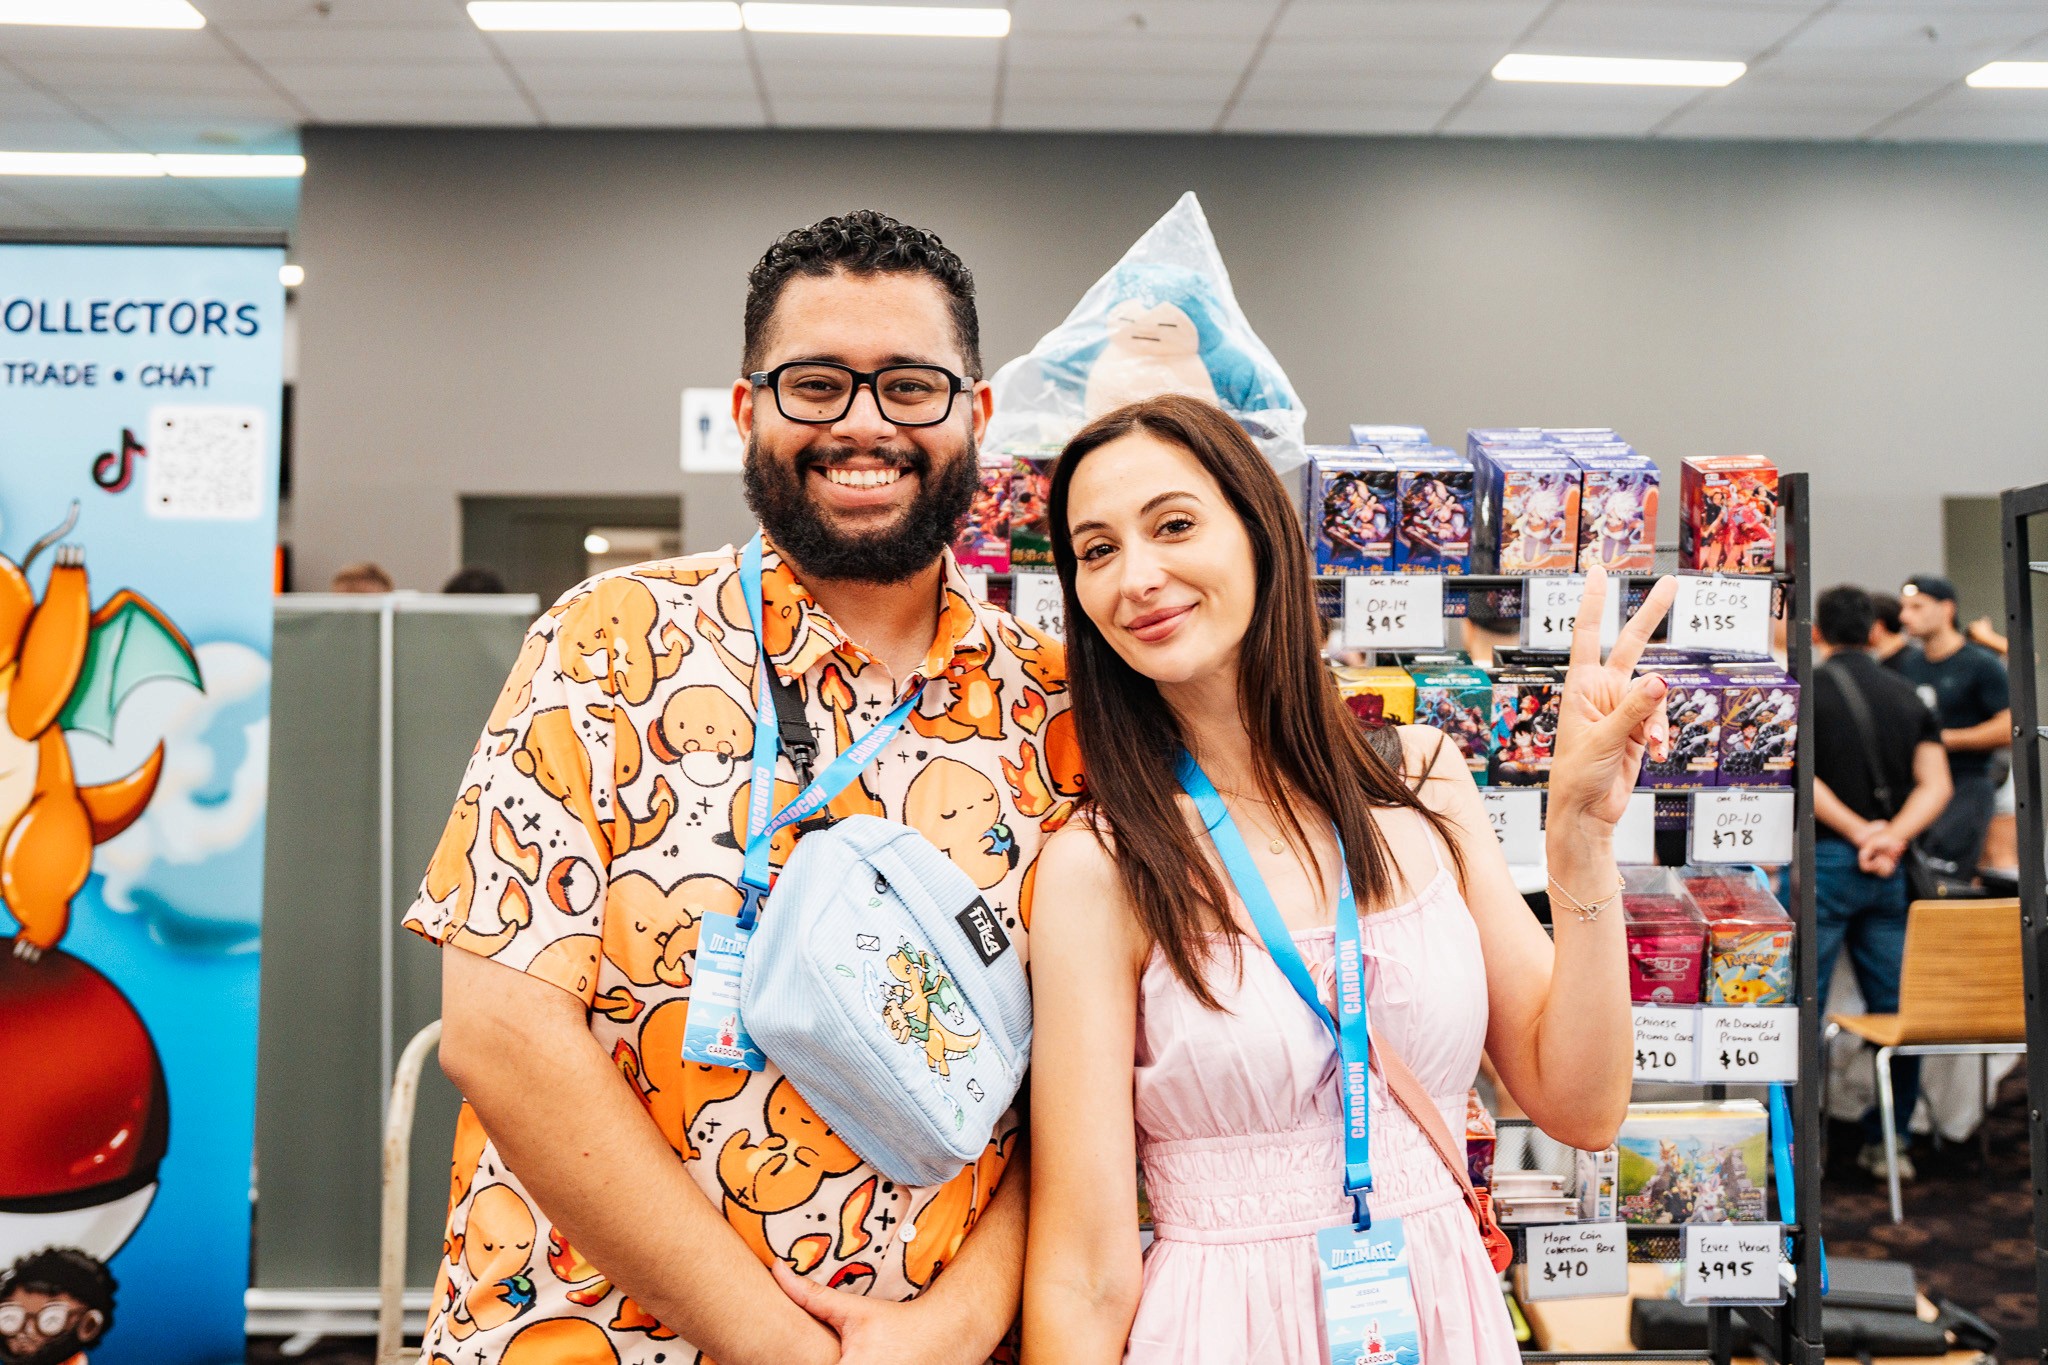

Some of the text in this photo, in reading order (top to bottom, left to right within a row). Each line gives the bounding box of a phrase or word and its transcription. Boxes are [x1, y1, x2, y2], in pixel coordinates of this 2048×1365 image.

[3, 299, 260, 337] OLLECTORS
[4, 363, 215, 388] TRADE CHAT
[1367, 599, 1407, 613] OP-14
[1694, 589, 1748, 610] EB-03
[1038, 615, 1063, 635] $8
[1366, 615, 1406, 635] $95
[1543, 616, 1576, 633] $13
[1689, 614, 1736, 633] $135
[846, 724, 897, 765] CARDCON
[750, 766, 771, 837] CARDCON
[763, 784, 828, 838] CARDCON
[1716, 813, 1762, 827] OP-10
[1712, 830, 1753, 849] $78
[708, 933, 748, 959] ULTIM
[1340, 939, 1363, 1015] CARDCON
[1635, 1016, 1677, 1028] Chinese
[1636, 1030, 1669, 1041] Promo
[1719, 1031, 1781, 1043] Promo Card
[708, 1045, 743, 1059] CARDCON
[1635, 1049, 1677, 1071] $20
[1719, 1049, 1760, 1070] $60
[1350, 1061, 1366, 1140] CARDCON
[1542, 1230, 1602, 1244] Hope Coin
[1700, 1237, 1771, 1254] Eevee Heroes
[1331, 1241, 1396, 1270] ULTIMATE
[1596, 1242, 1616, 1254] Box
[1543, 1260, 1589, 1282] $40
[1698, 1261, 1754, 1283] $995
